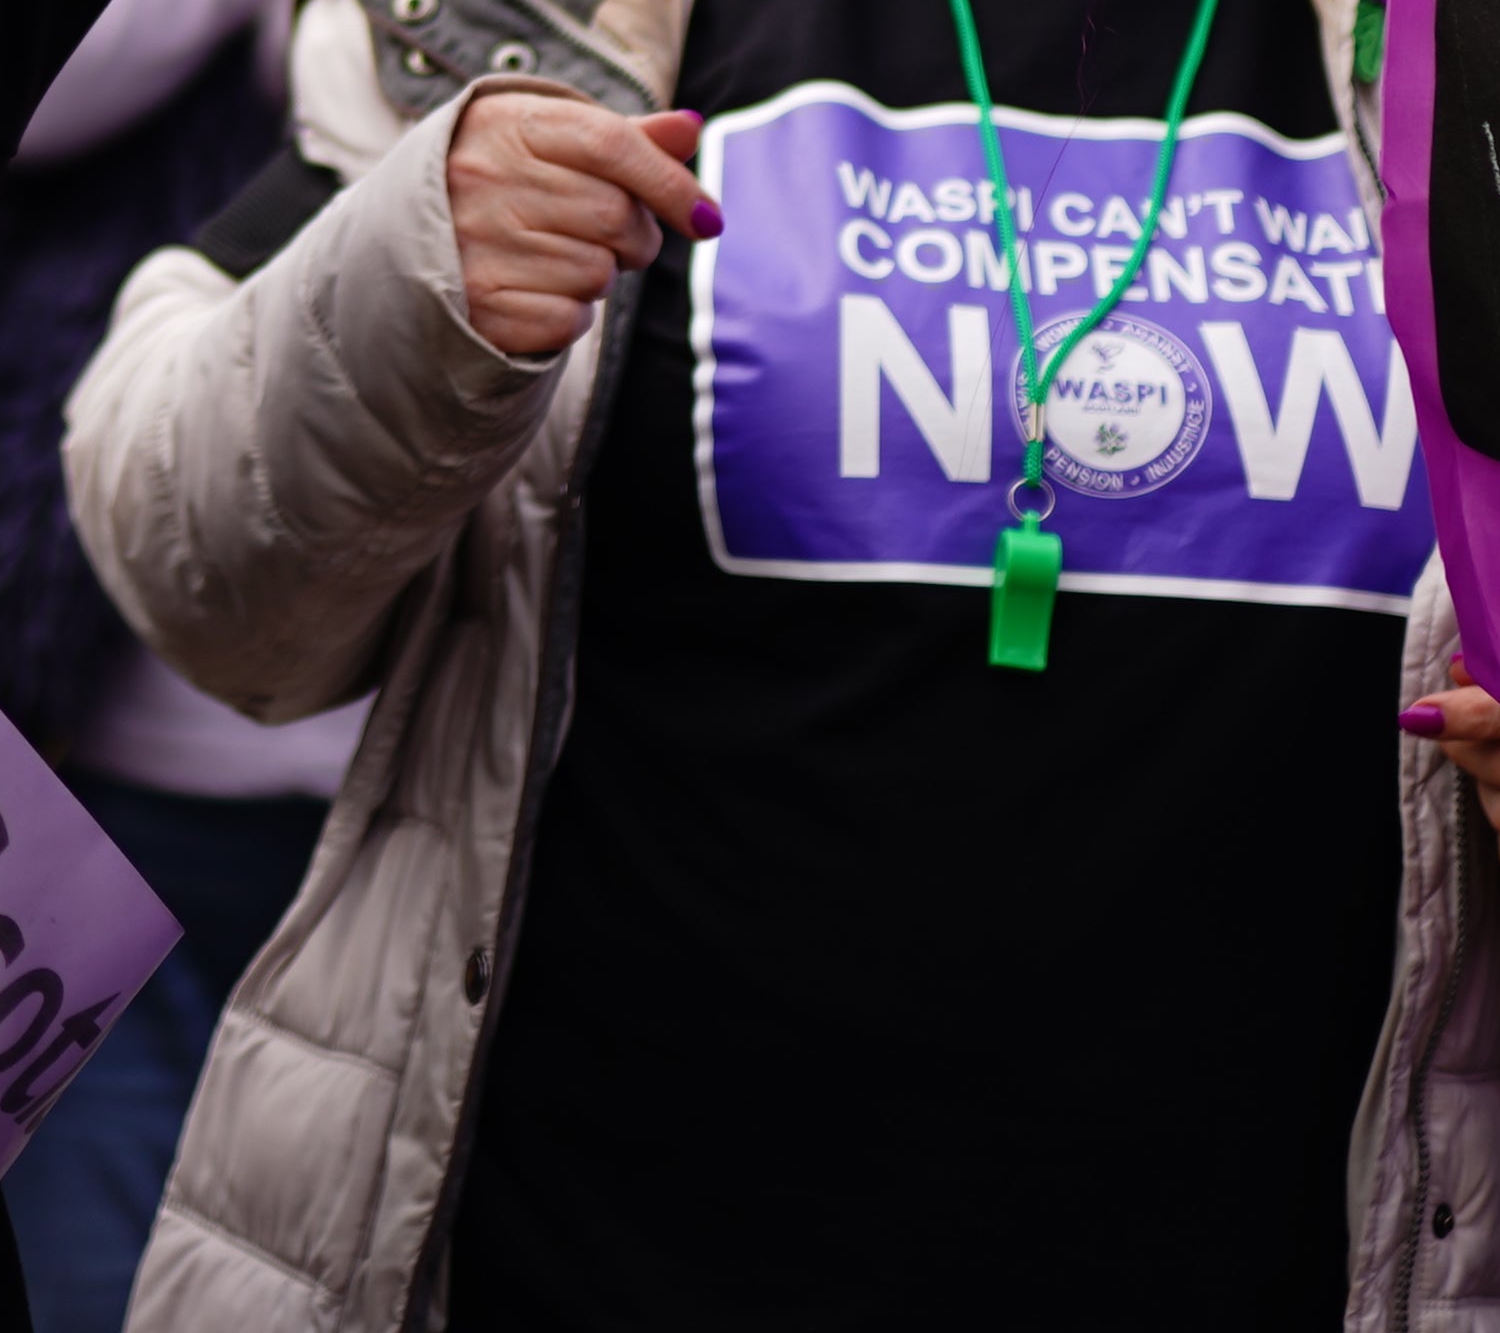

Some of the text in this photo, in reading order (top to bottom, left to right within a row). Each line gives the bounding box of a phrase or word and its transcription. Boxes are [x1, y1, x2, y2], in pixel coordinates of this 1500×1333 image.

[836, 161, 1035, 231] WASPI
[1049, 188, 1245, 241] CAN'T
[1056, 379, 1168, 406] WASPI
